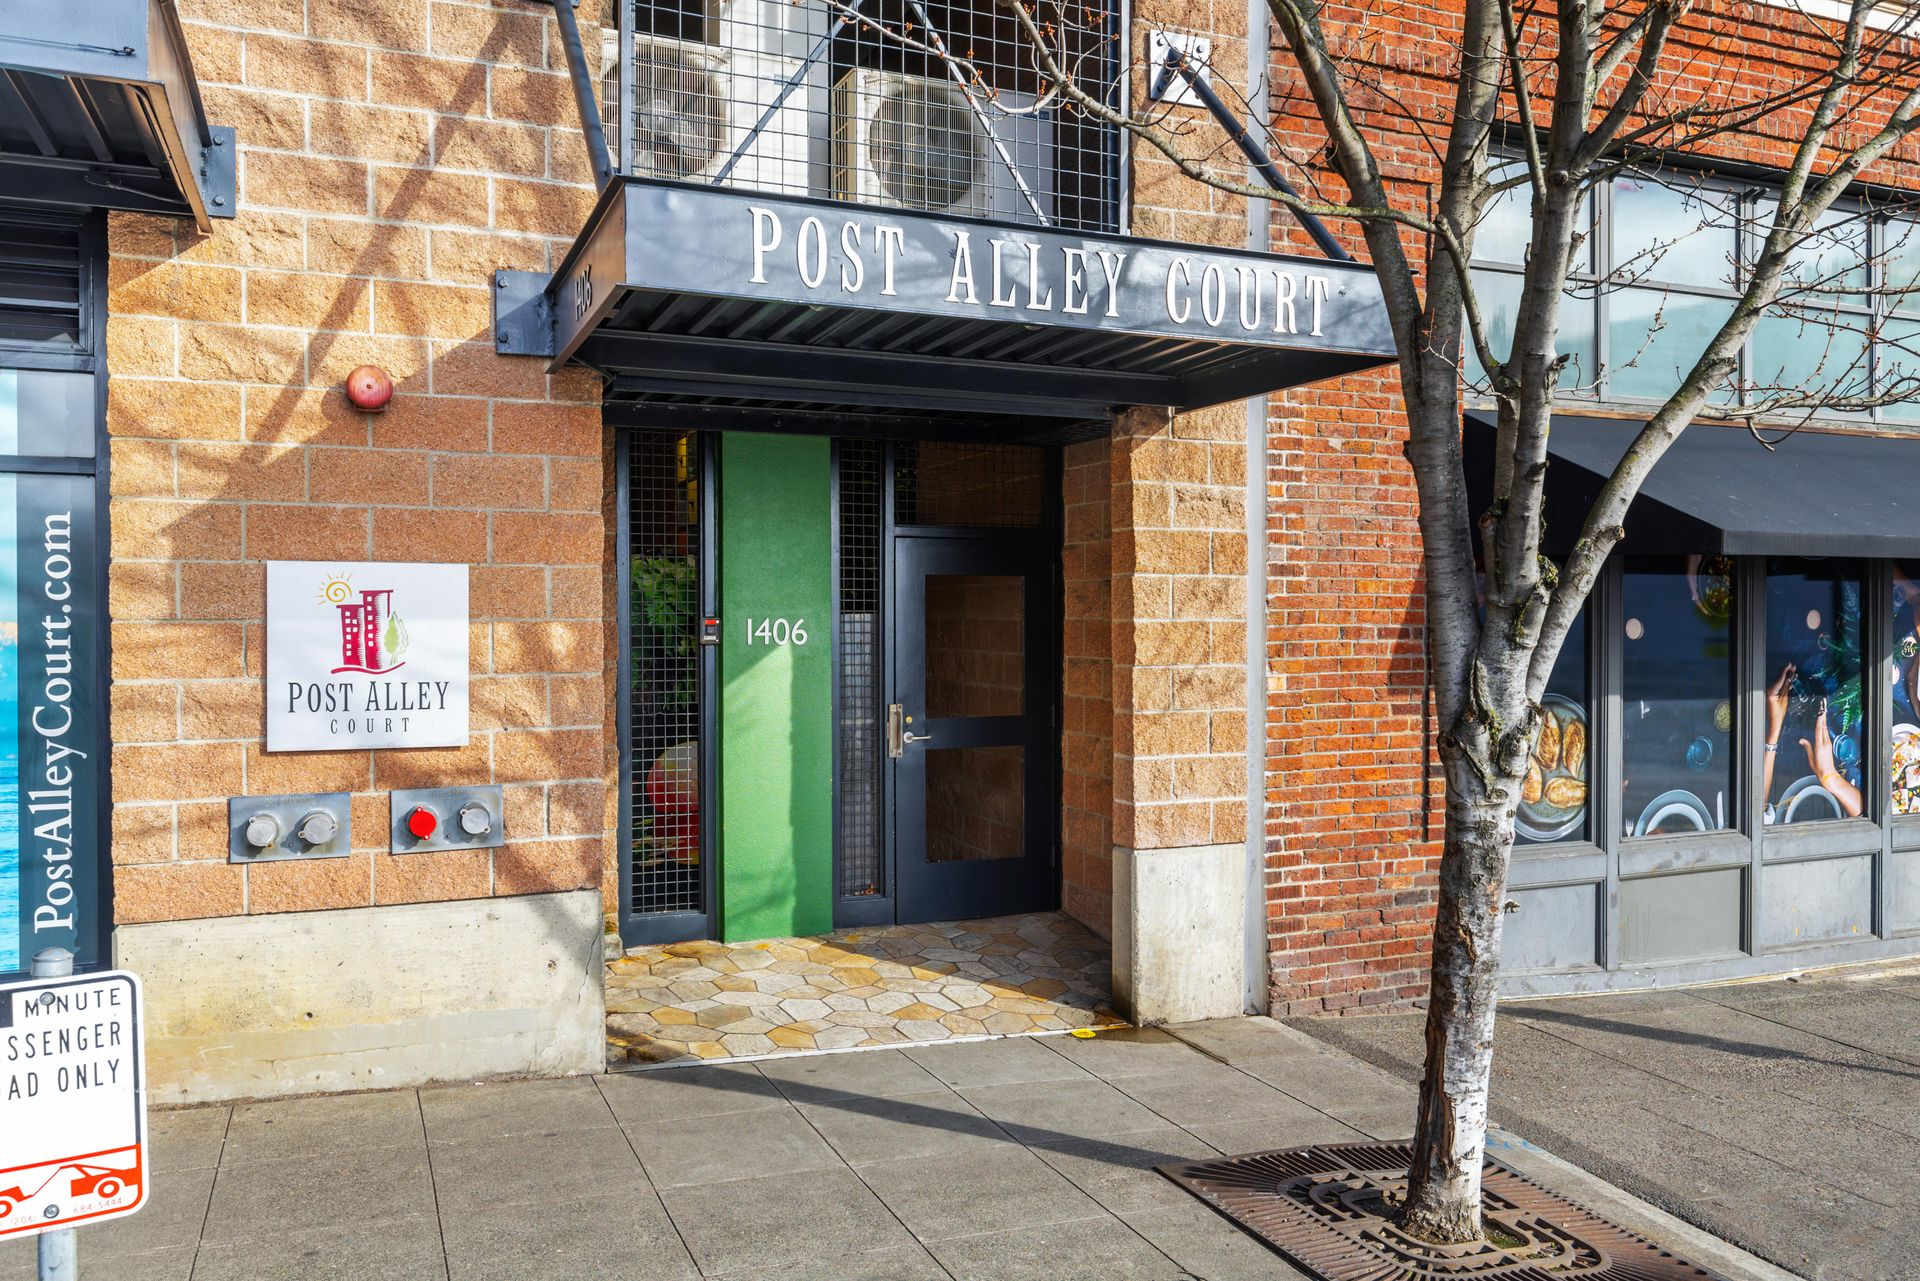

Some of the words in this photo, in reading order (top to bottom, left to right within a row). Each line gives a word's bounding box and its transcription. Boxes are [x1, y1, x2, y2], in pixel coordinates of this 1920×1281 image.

[749, 207, 904, 296] POST
[944, 231, 1127, 318] ALLEY
[1165, 256, 1328, 337] COURT
[746, 617, 808, 645] 1406
[288, 682, 353, 713] POST
[365, 680, 450, 712] ALLEY
[28, 511, 88, 934] PostAlleyCourt.com
[330, 717, 409, 734] COURT
[25, 988, 121, 1018] MINUTE
[57, 1058, 120, 1092] ONLY
